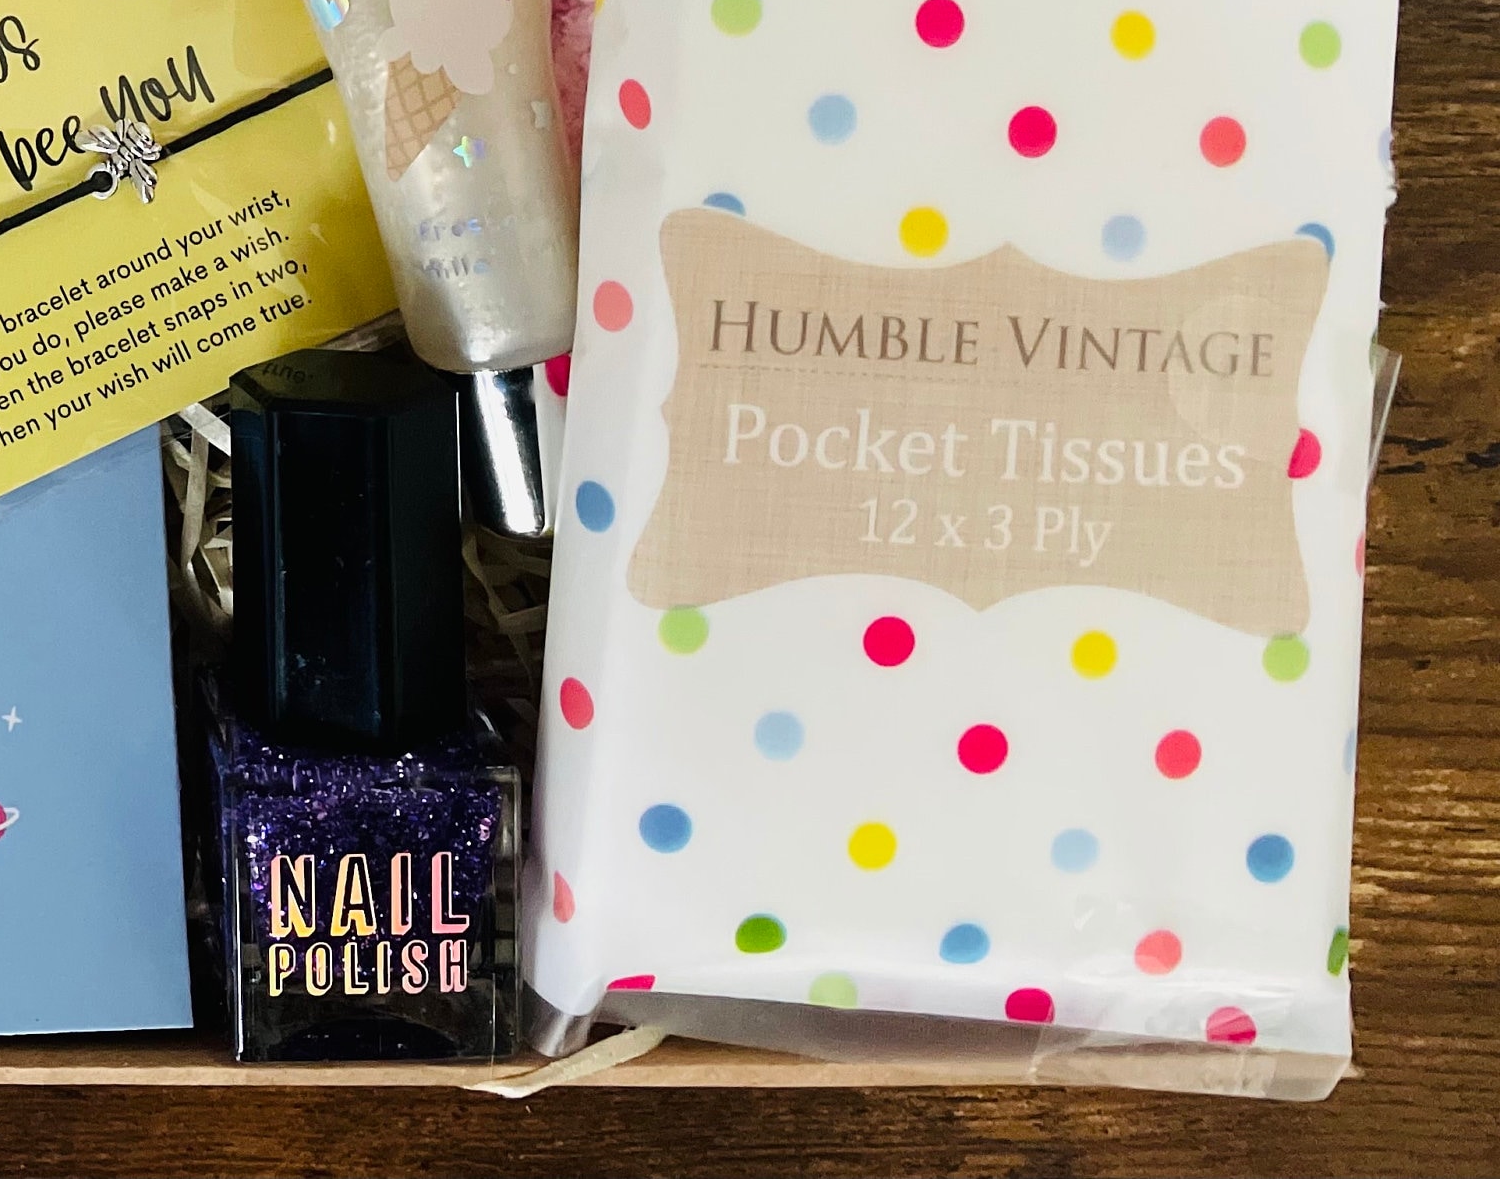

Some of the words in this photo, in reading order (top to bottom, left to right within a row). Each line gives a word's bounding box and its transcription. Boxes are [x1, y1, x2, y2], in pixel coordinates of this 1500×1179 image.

[100, 45, 215, 124] you
[0, 278, 93, 334] bracelet
[98, 238, 173, 290] around
[176, 220, 224, 257] your
[228, 189, 292, 227] wrist,
[32, 332, 71, 358] do,
[74, 295, 146, 343] please
[150, 262, 209, 300] make
[213, 256, 229, 272] a
[231, 227, 290, 261] wish.
[27, 365, 65, 396] the
[70, 321, 161, 377] bracelet
[164, 292, 228, 333] snaps
[230, 279, 254, 300] in
[256, 258, 309, 290] two,
[44, 392, 93, 433] your
[97, 363, 149, 400] wish
[152, 340, 193, 374] will
[197, 316, 258, 353] come
[260, 293, 313, 324] true.
[710, 300, 980, 365] HUMBLE
[1008, 315, 1274, 377] VINTAGE
[722, 403, 968, 479] Pocket
[990, 419, 1246, 487] Tissues
[858, 498, 916, 545] 12
[934, 519, 964, 548] x
[985, 505, 1013, 550] 3
[1034, 504, 1113, 567] Ply
[269, 851, 470, 938] NAIL
[268, 938, 468, 996] POLISH
